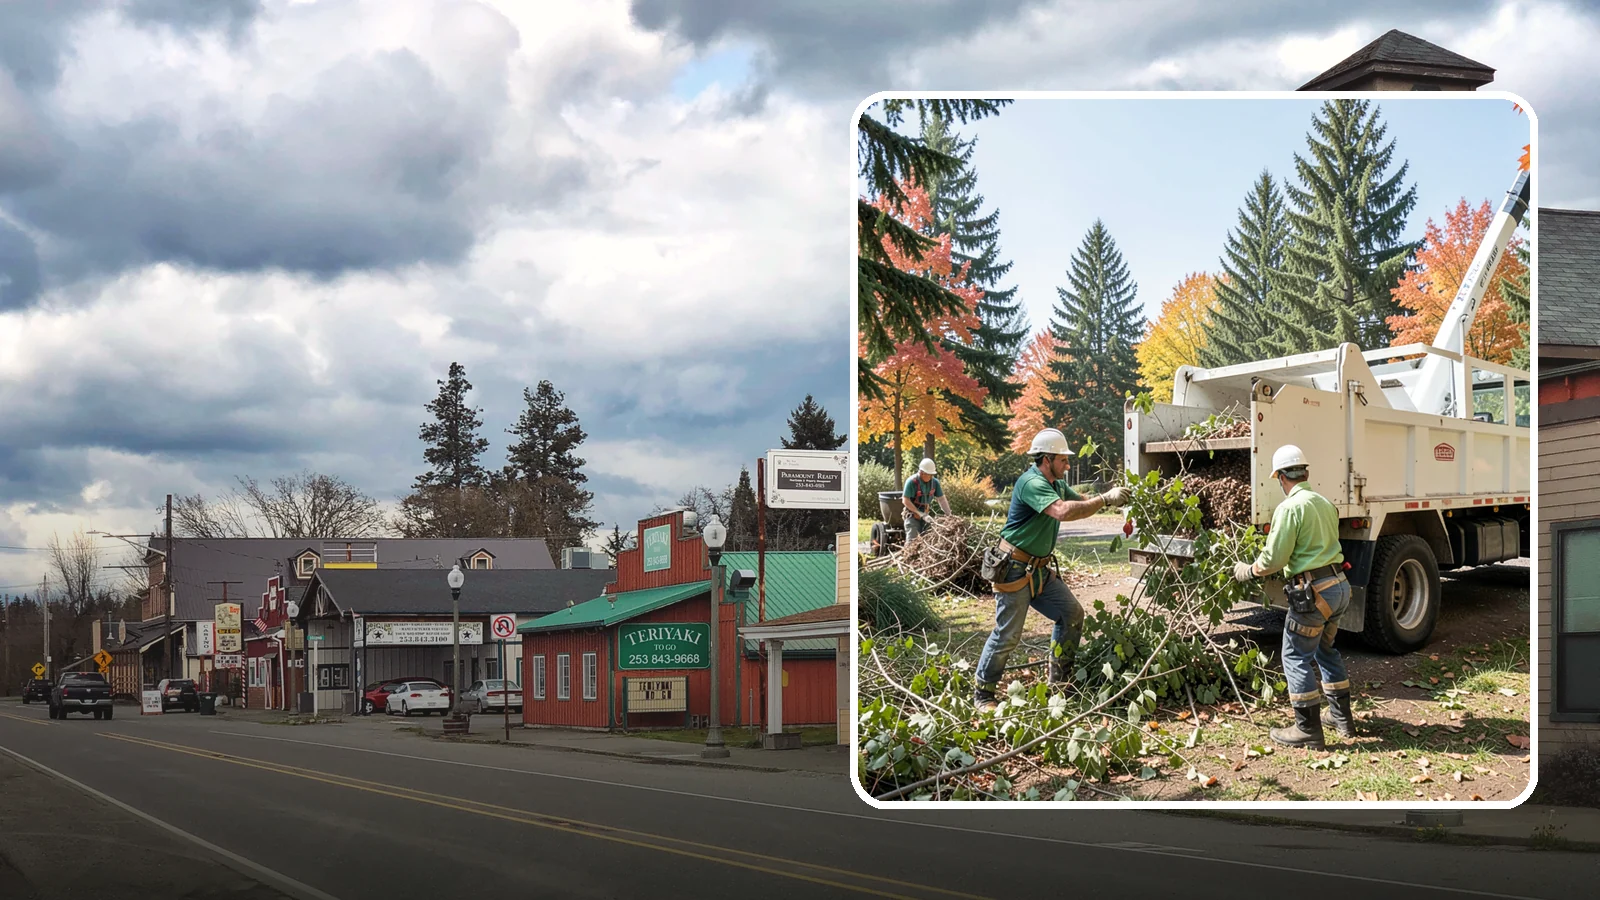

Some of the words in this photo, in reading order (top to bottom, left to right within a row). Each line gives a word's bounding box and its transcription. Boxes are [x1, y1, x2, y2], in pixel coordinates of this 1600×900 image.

[625, 627, 702, 646] TERIYAKI
[629, 654, 648, 664] 253
[651, 654, 700, 664] 843-9668
[639, 681, 672, 690] TERIYAKI
